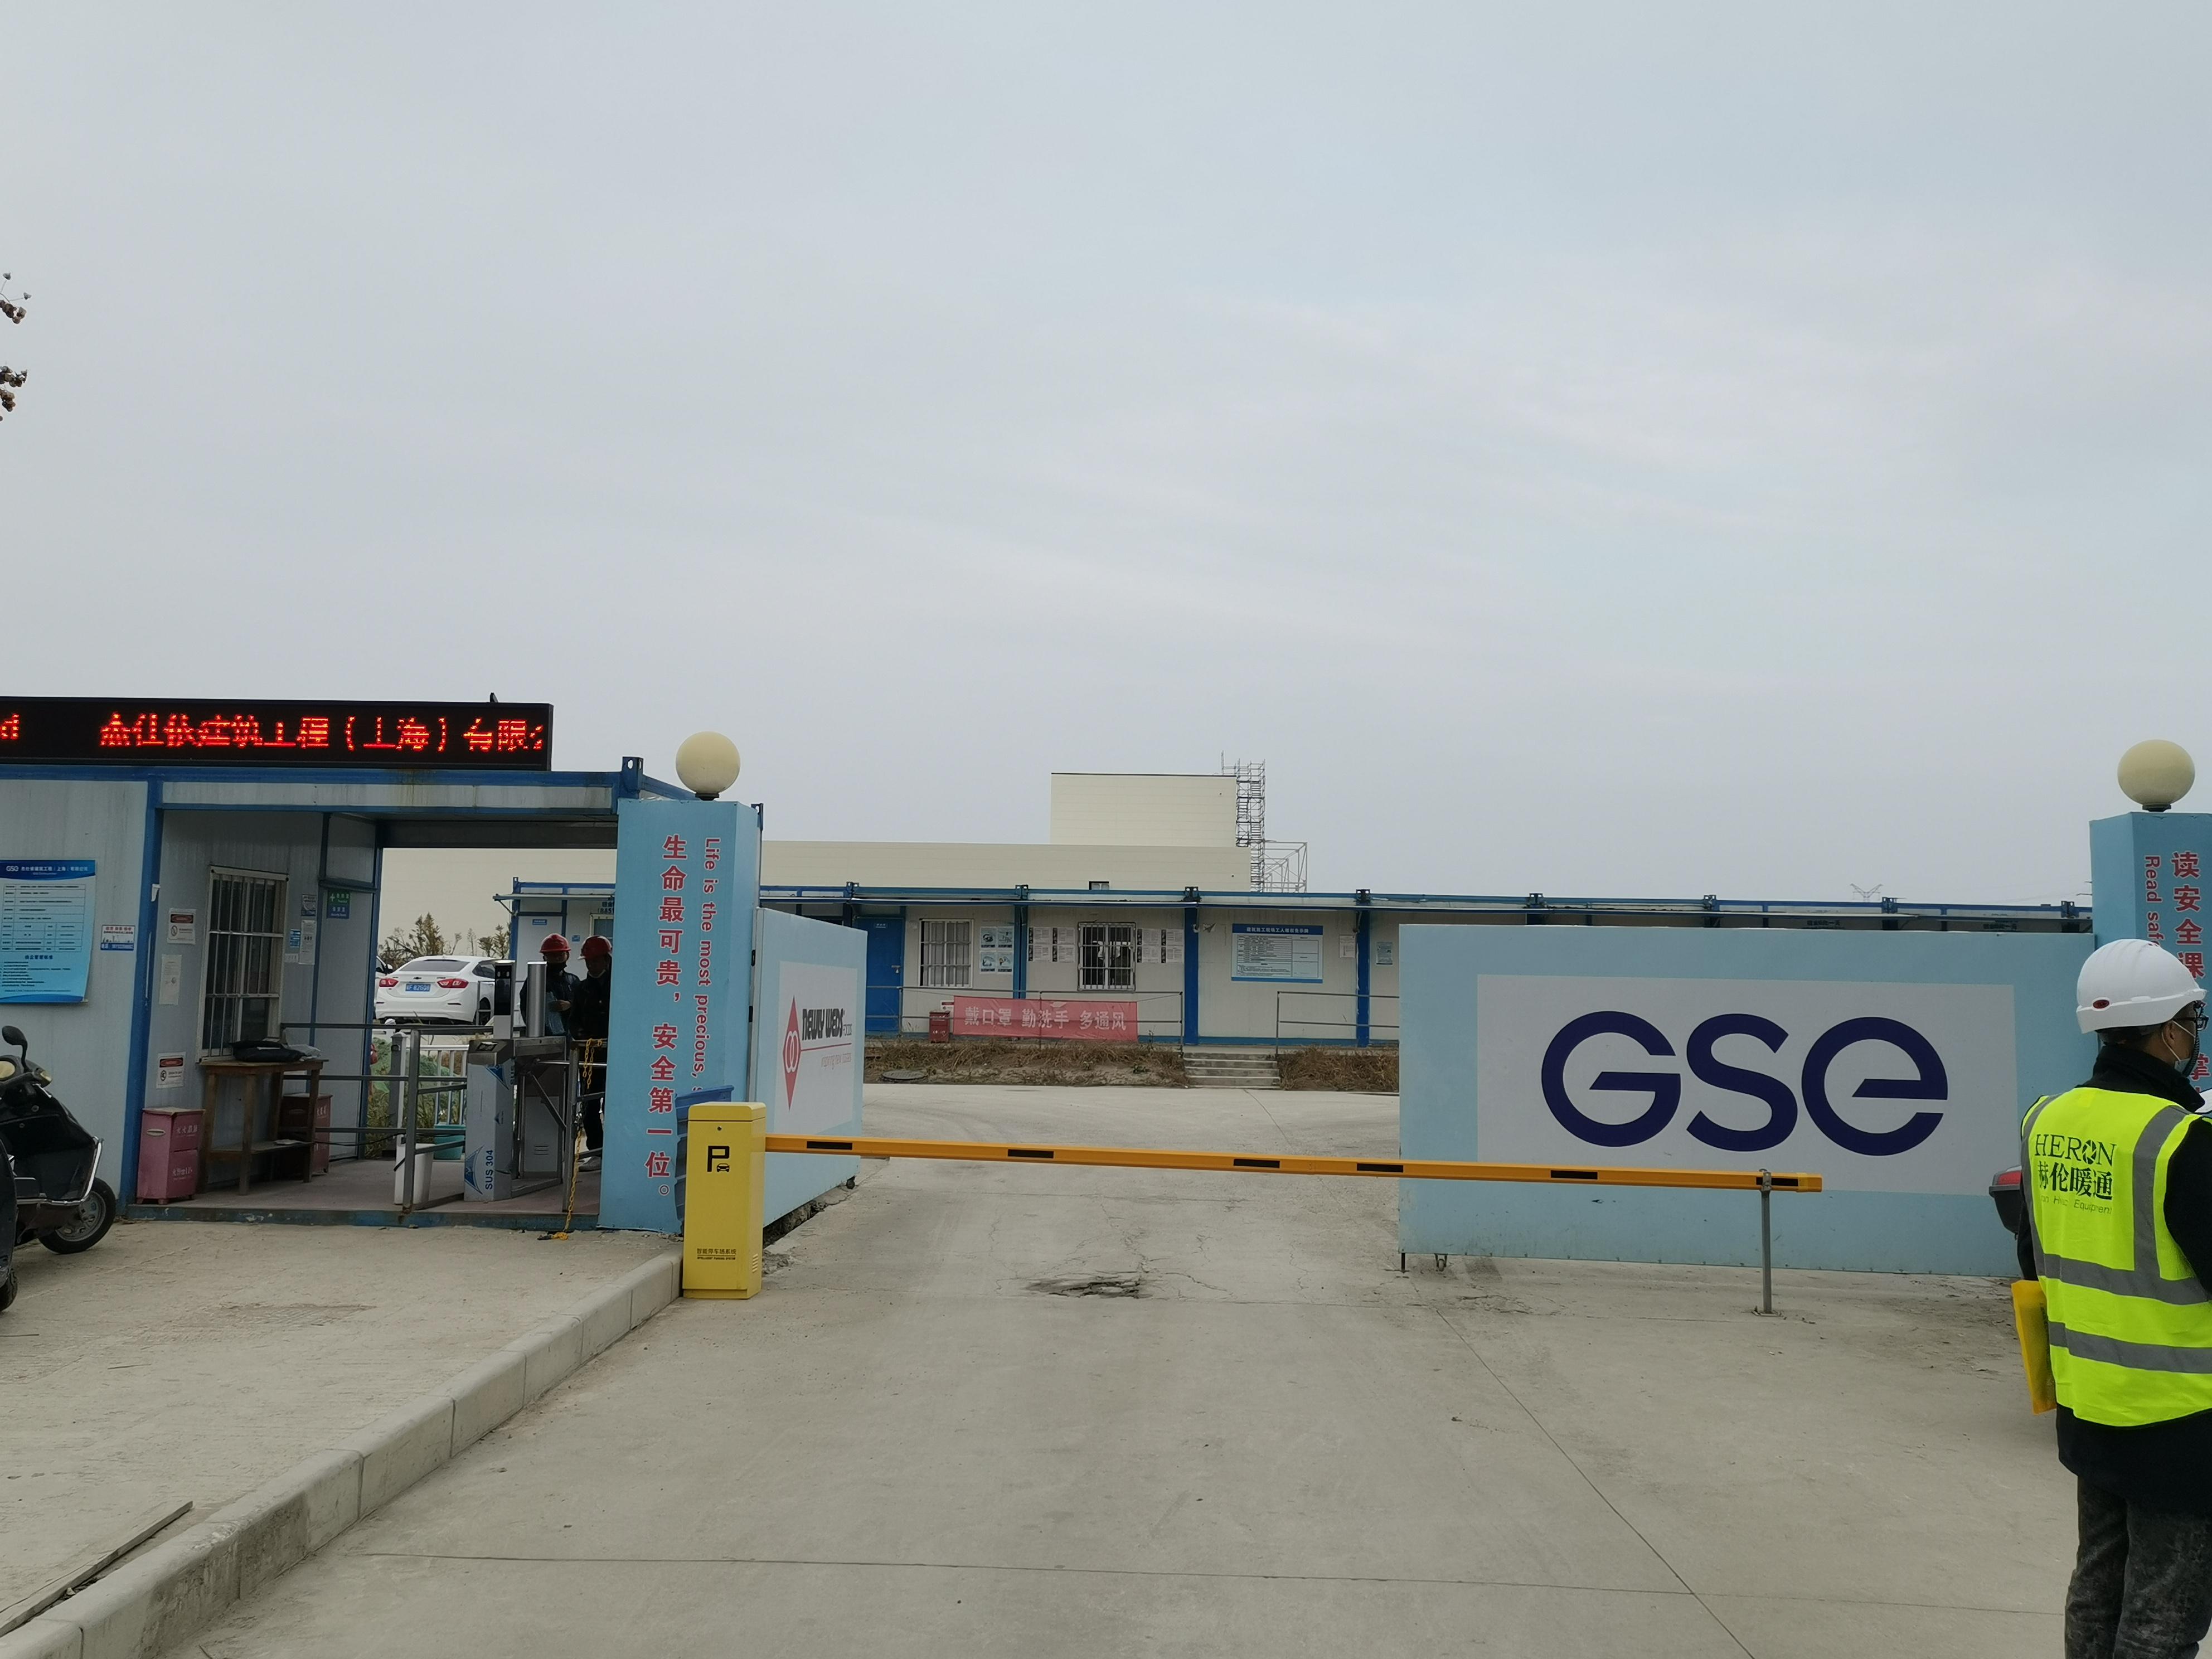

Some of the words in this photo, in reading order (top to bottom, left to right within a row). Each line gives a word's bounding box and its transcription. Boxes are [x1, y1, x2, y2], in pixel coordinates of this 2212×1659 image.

[705, 838, 720, 871] Life
[703, 879, 719, 894] is
[2145, 855, 2162, 903] Read
[701, 901, 716, 932] the
[698, 940, 711, 986] most
[964, 1006, 1012, 1026] 戴口罩
[1021, 1008, 1070, 1029] 勤洗手
[1079, 1010, 1126, 1031] 多通风
[691, 994, 710, 1078] precious,
[707, 1145, 730, 1172] P
[2035, 1134, 2117, 1166] HERON
[2038, 1161, 2113, 1200] 赫伦暖通
